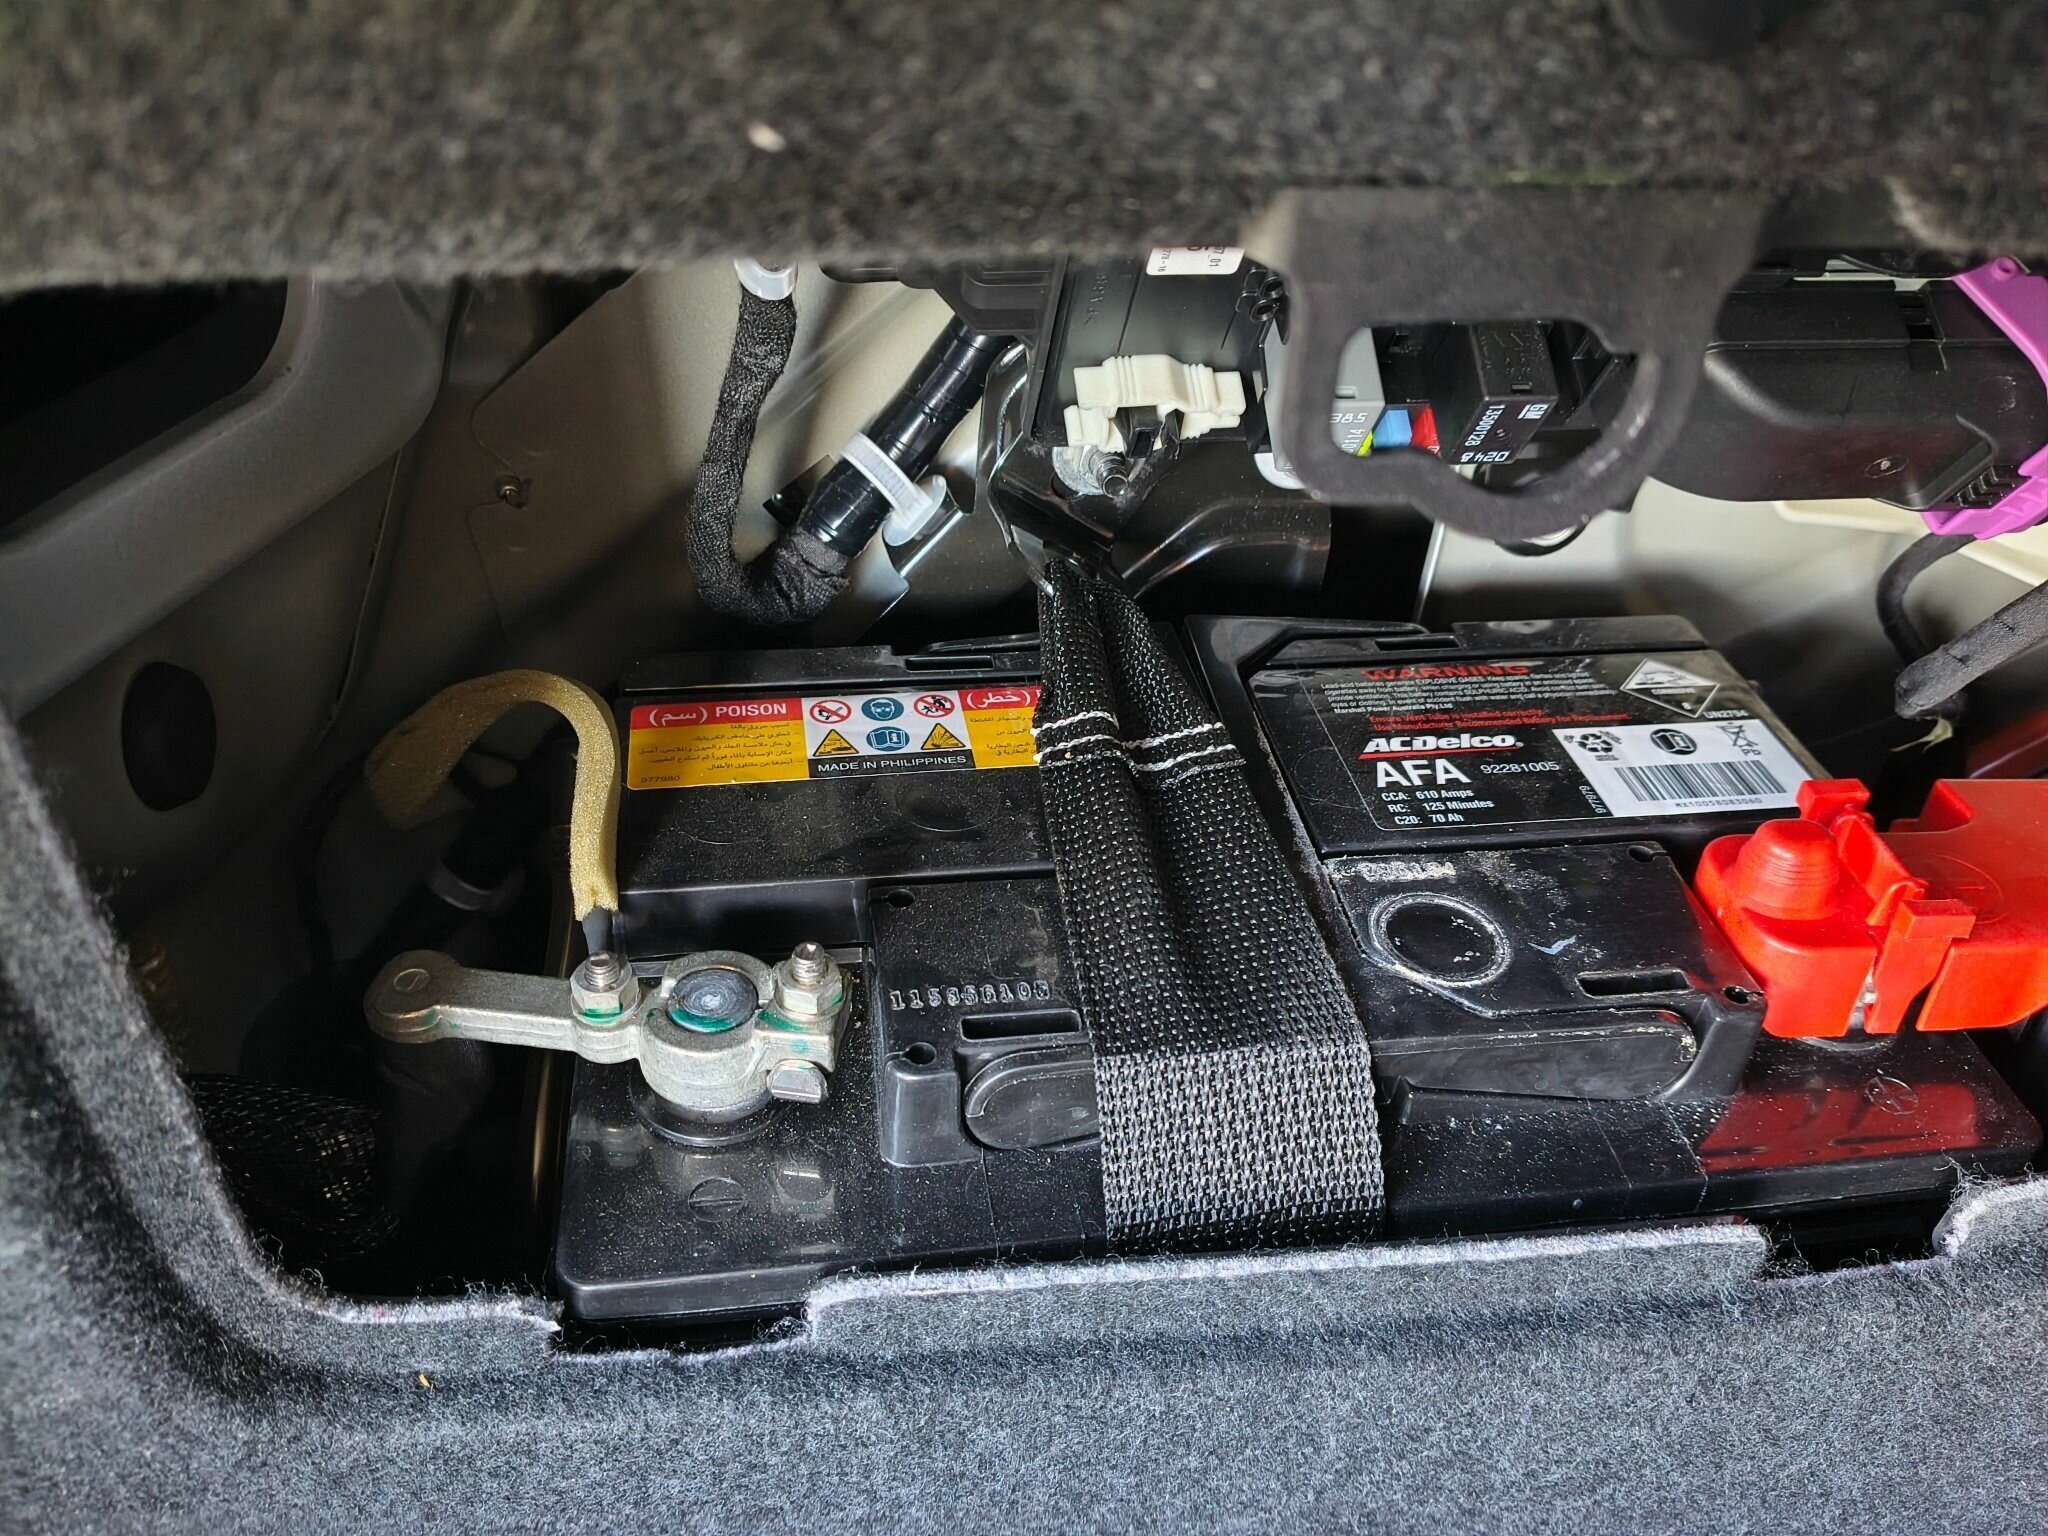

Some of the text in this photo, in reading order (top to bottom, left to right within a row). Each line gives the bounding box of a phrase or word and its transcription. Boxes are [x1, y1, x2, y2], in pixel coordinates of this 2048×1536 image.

[1522, 404, 1550, 419] GM
[1465, 404, 1506, 446] 13500128
[1361, 666, 1529, 681] WARNING
[715, 703, 787, 718] POISON
[1362, 733, 1516, 753] ACDelco
[818, 755, 967, 772] MADE IN PHILIPPINES
[1480, 761, 1560, 774] 92281005
[1376, 758, 1472, 788] AFA
[1381, 790, 1474, 802] CCA: 610 Amps
[1579, 785, 1606, 814] 977979
[1388, 800, 1494, 813] RC: 125 Minutes
[1394, 814, 1464, 825] C20: 70 Ah
